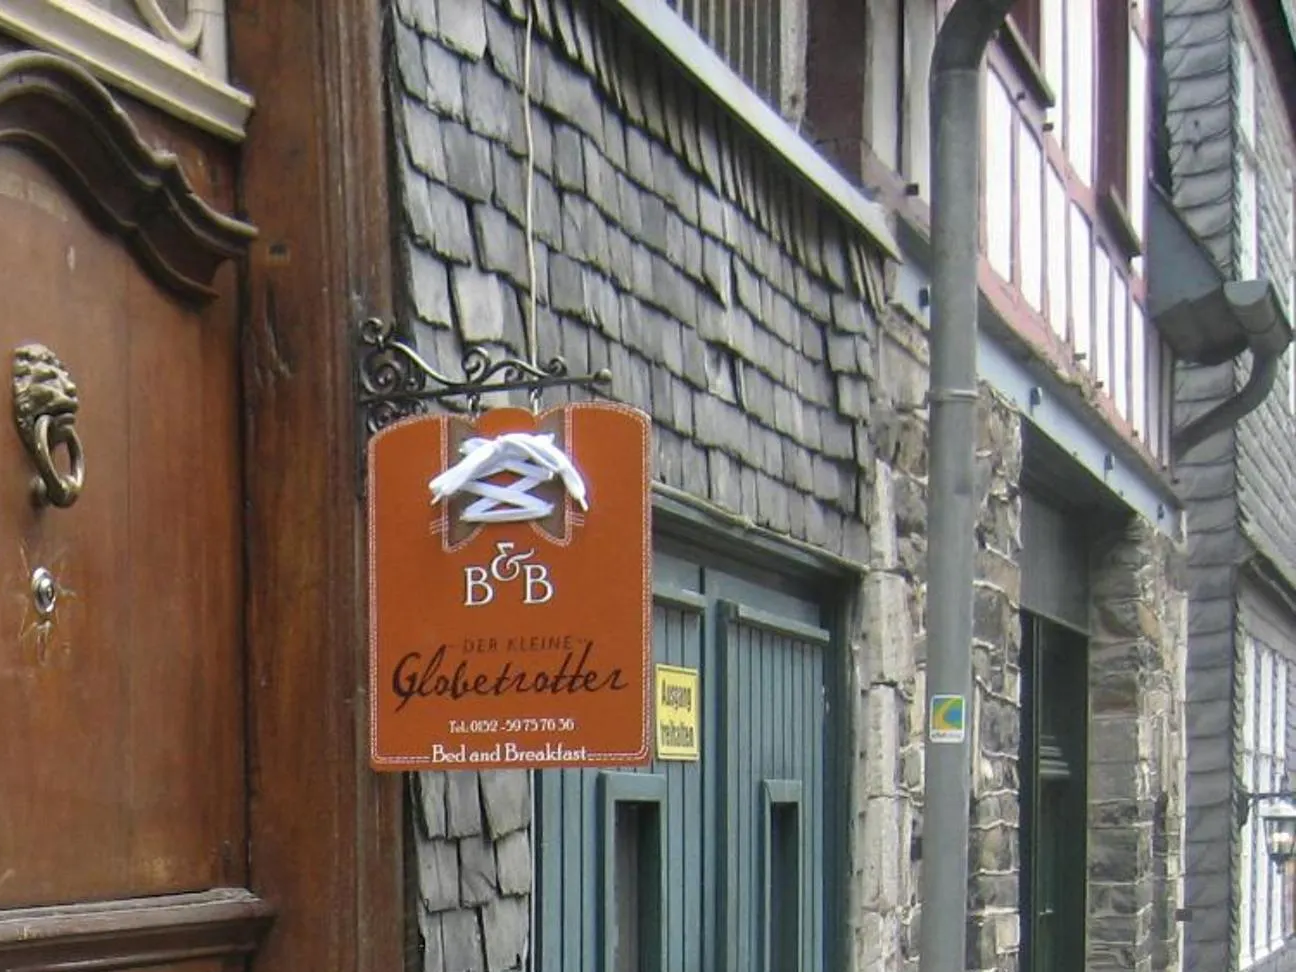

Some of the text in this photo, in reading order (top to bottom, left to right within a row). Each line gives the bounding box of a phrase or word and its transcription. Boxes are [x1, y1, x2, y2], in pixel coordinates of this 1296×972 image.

[462, 635, 572, 653] DER KLEINE
[391, 640, 629, 713] Globetrotter
[432, 742, 587, 763] Bed and Breakfast
